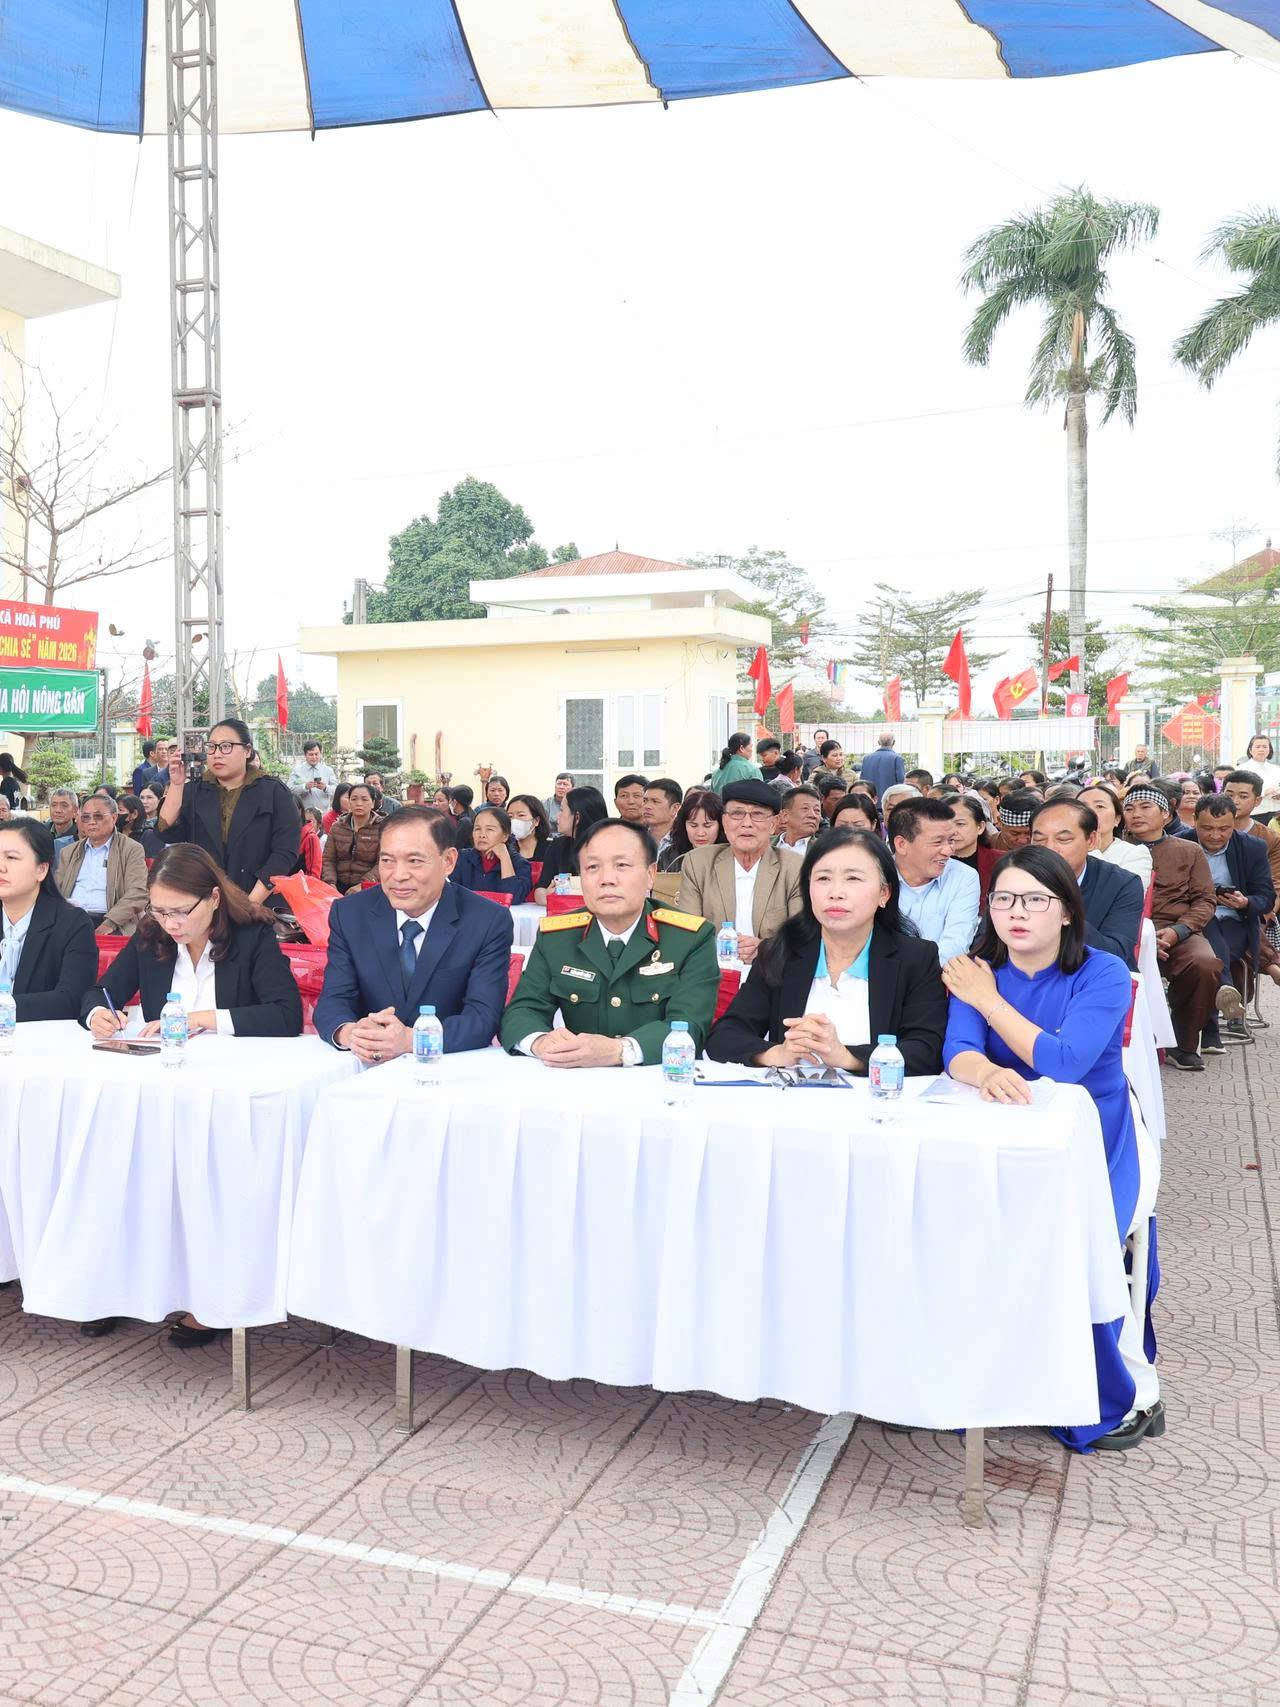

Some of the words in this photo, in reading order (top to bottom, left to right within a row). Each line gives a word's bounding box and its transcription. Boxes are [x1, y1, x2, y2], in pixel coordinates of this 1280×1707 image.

[15, 611, 36, 628] HOÀ
[39, 615, 60, 630] PHÚ
[38, 636, 57, 660] NĂM
[58, 642, 78, 662] 2026
[11, 683, 31, 719] HỘI
[32, 685, 62, 714] NÔNG
